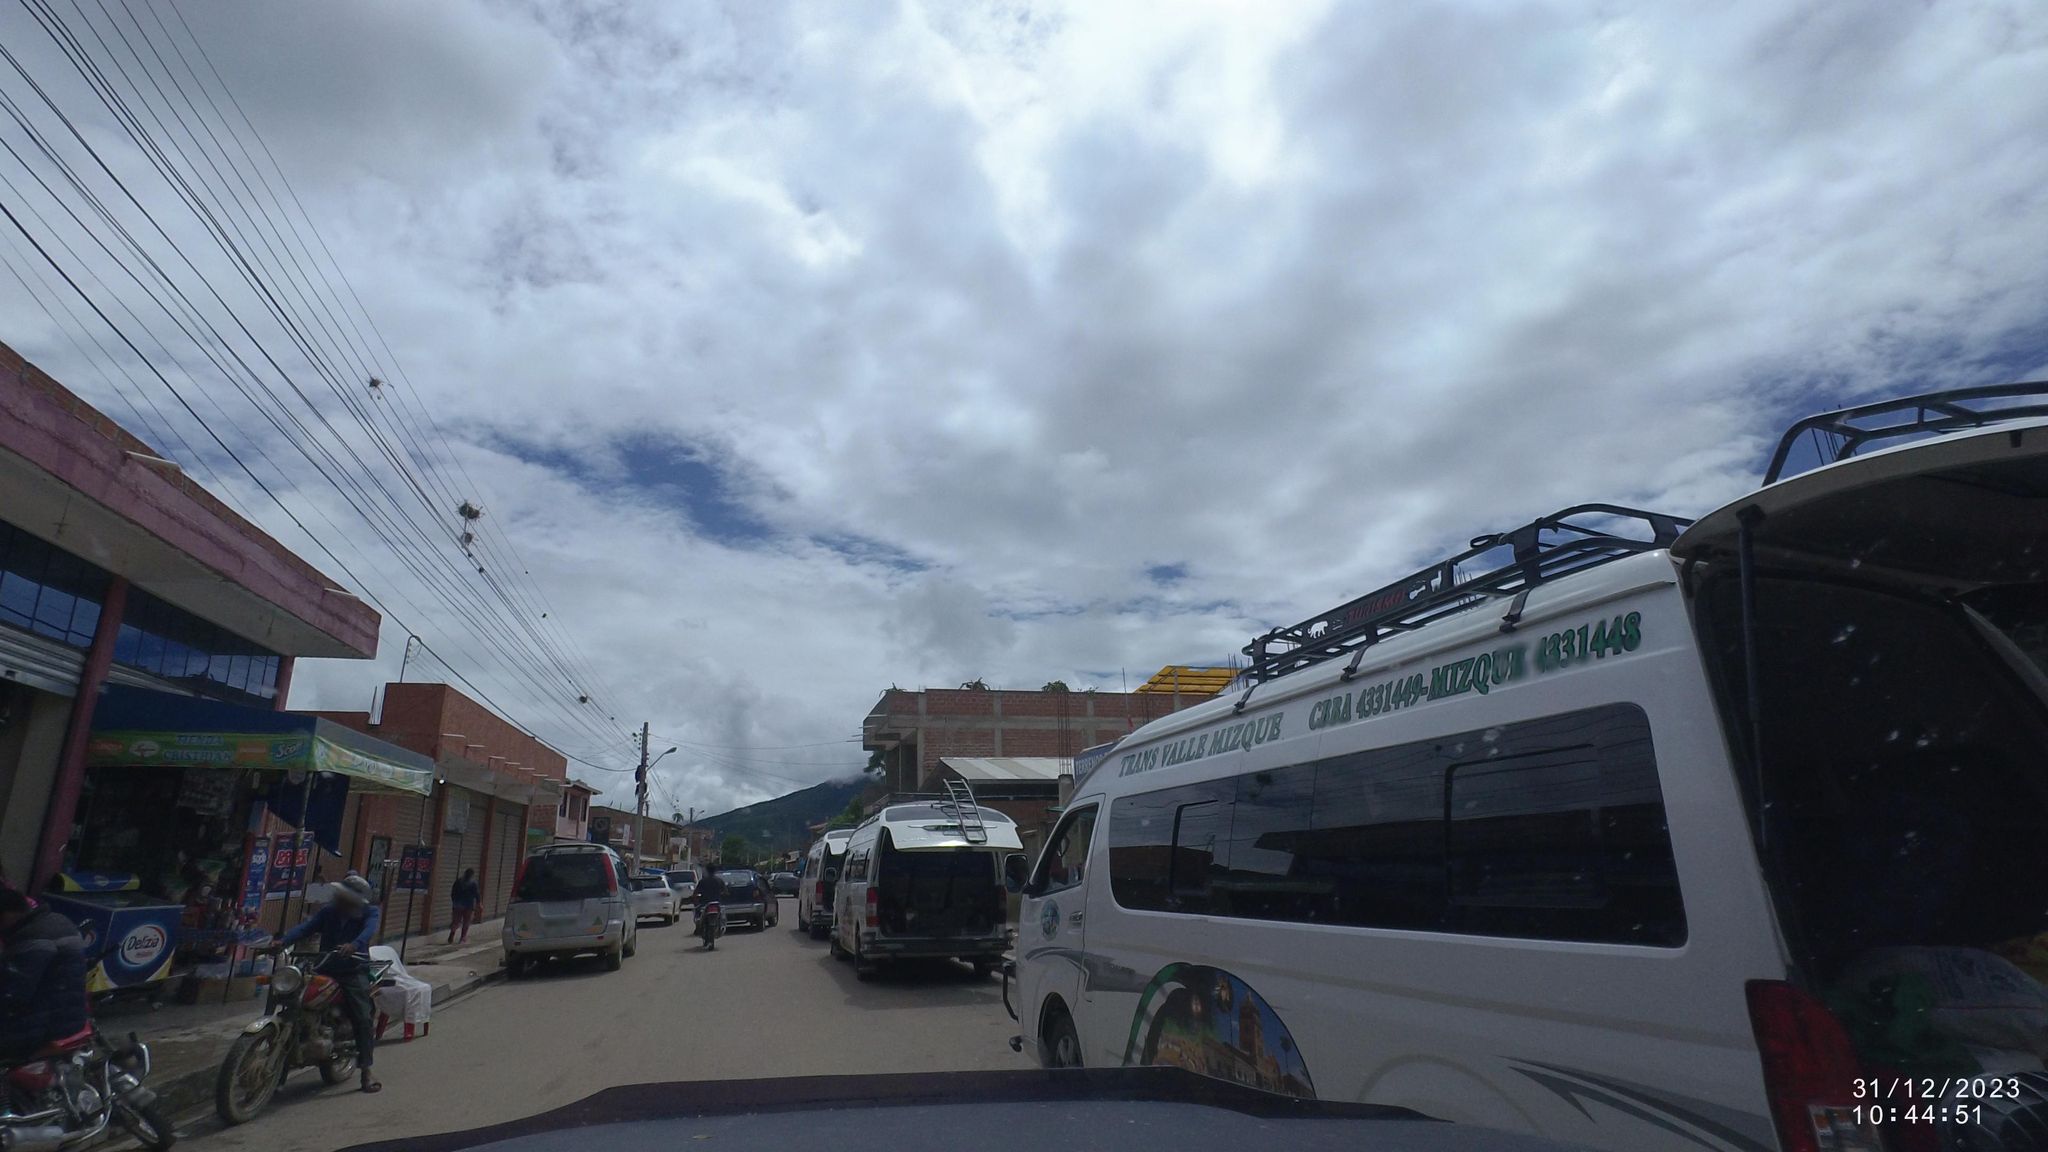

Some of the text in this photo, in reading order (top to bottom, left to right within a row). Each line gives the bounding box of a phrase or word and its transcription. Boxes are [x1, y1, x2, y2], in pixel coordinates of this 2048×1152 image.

[1118, 712, 1284, 778] TRANS VALLE MIZQUE
